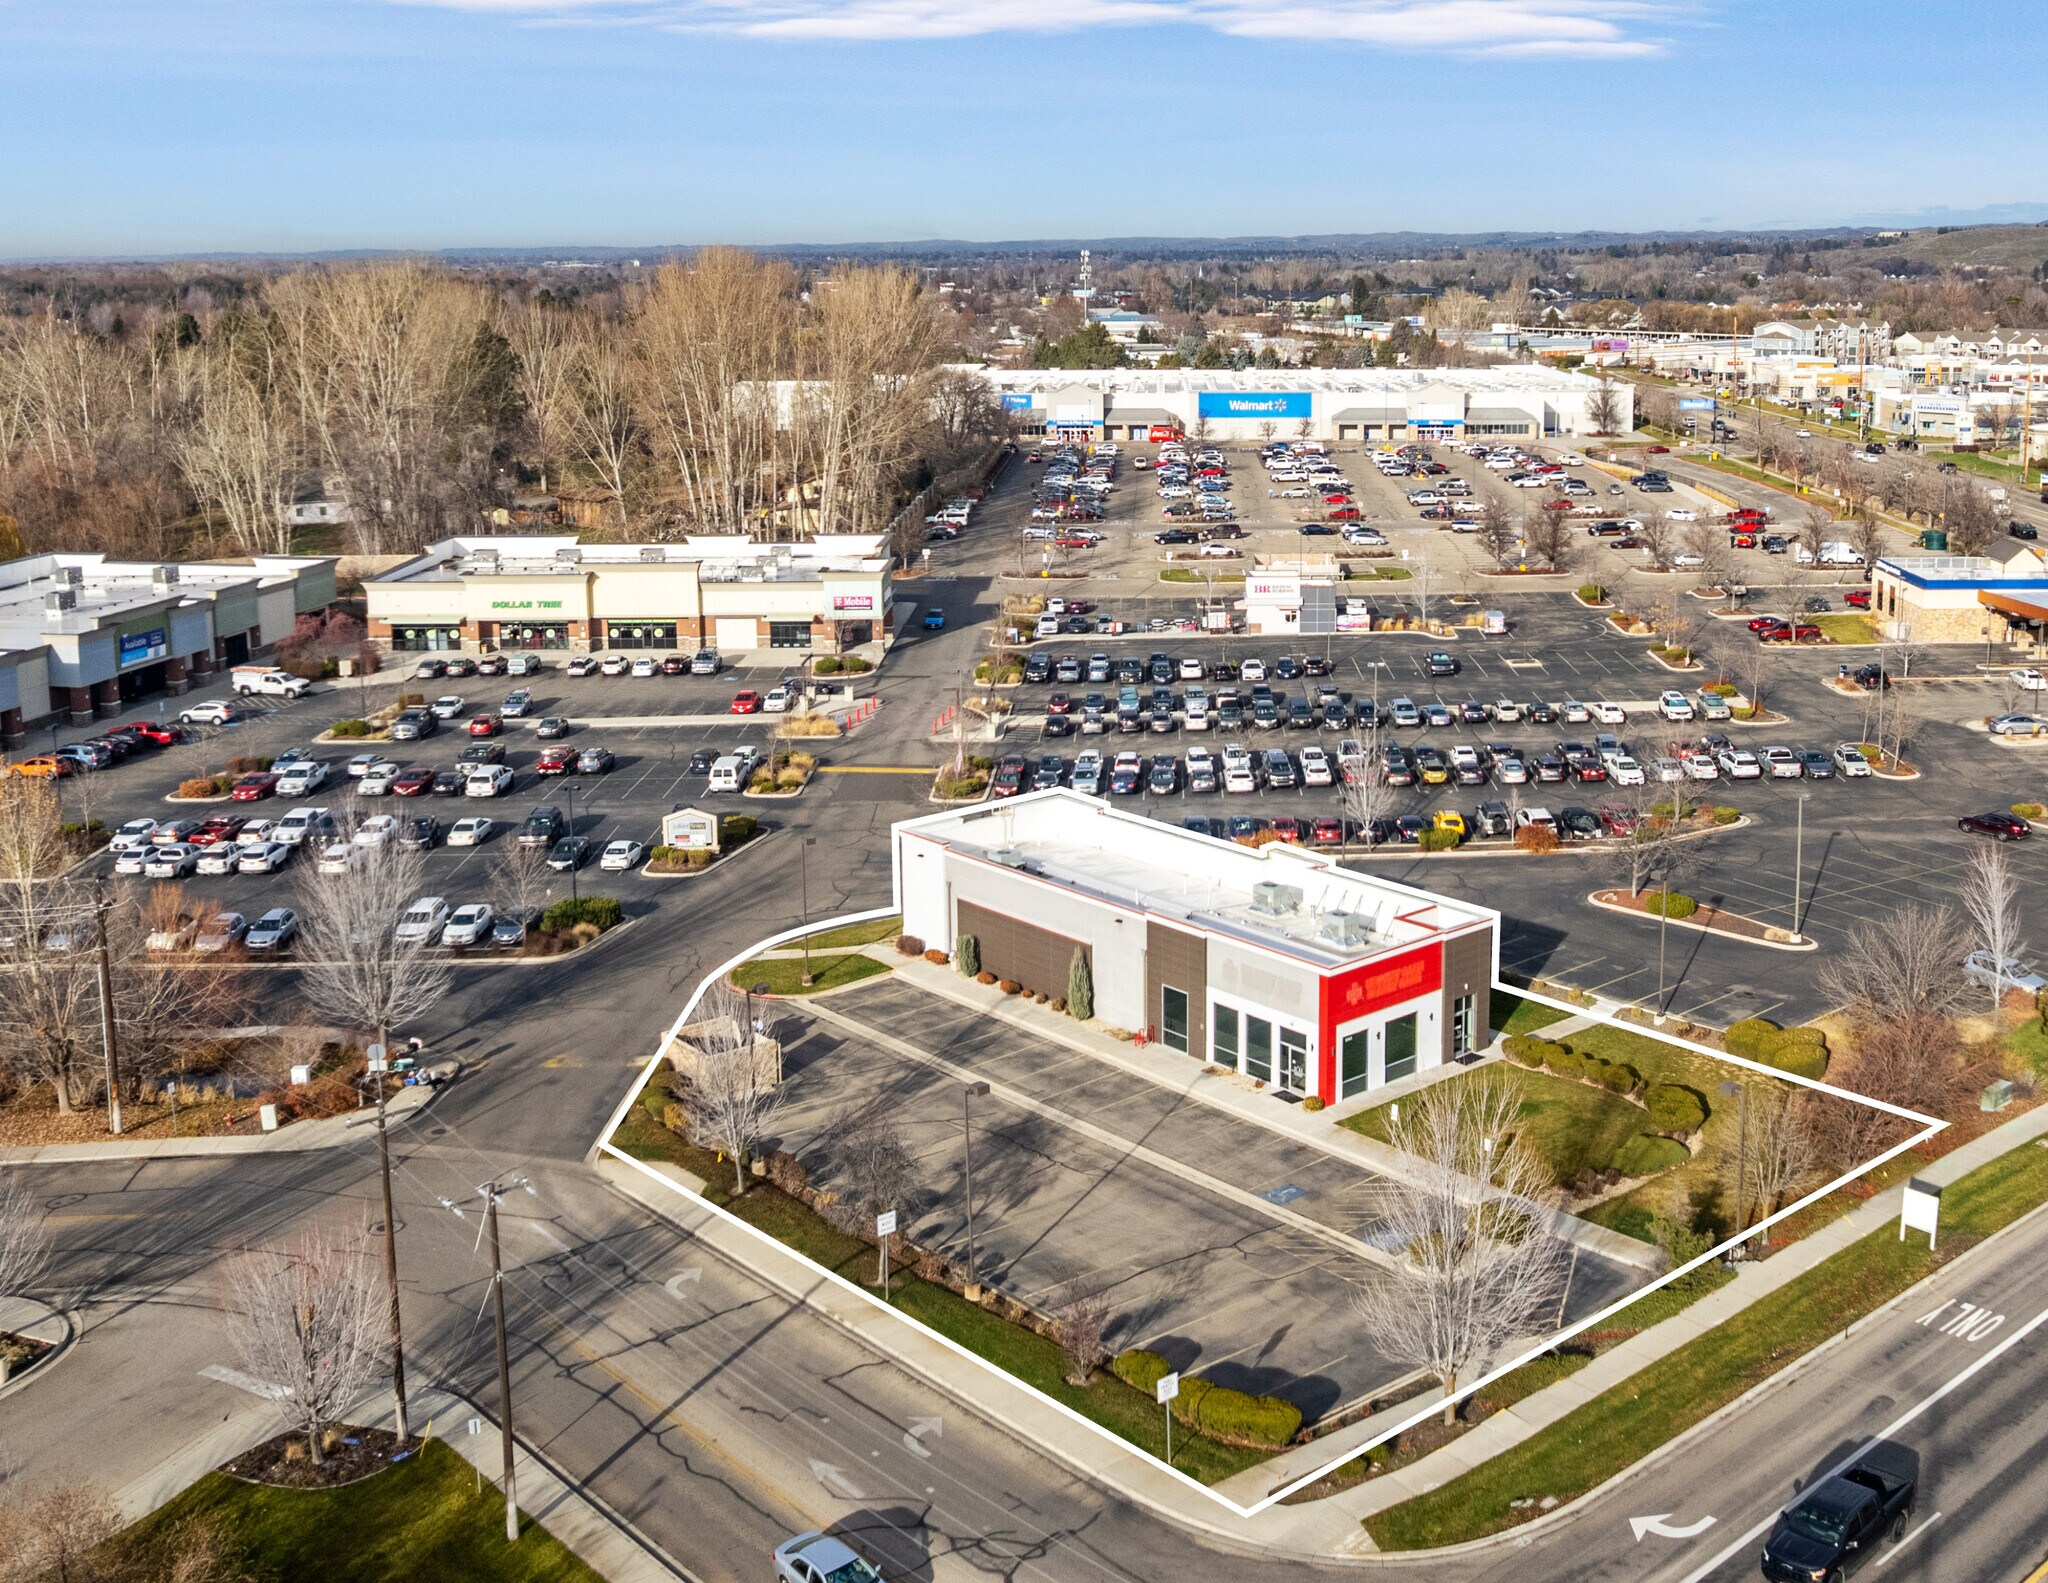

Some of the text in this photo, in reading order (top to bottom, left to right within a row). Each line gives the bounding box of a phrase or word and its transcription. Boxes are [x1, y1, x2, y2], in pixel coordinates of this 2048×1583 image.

[1229, 400, 1273, 411] Walmart
[1254, 584, 1271, 593] BR
[492, 601, 533, 609] DOLLAR
[844, 597, 871, 606] Mobile
[125, 638, 147, 649] Available
[1915, 1298, 2006, 1342] ONLY
